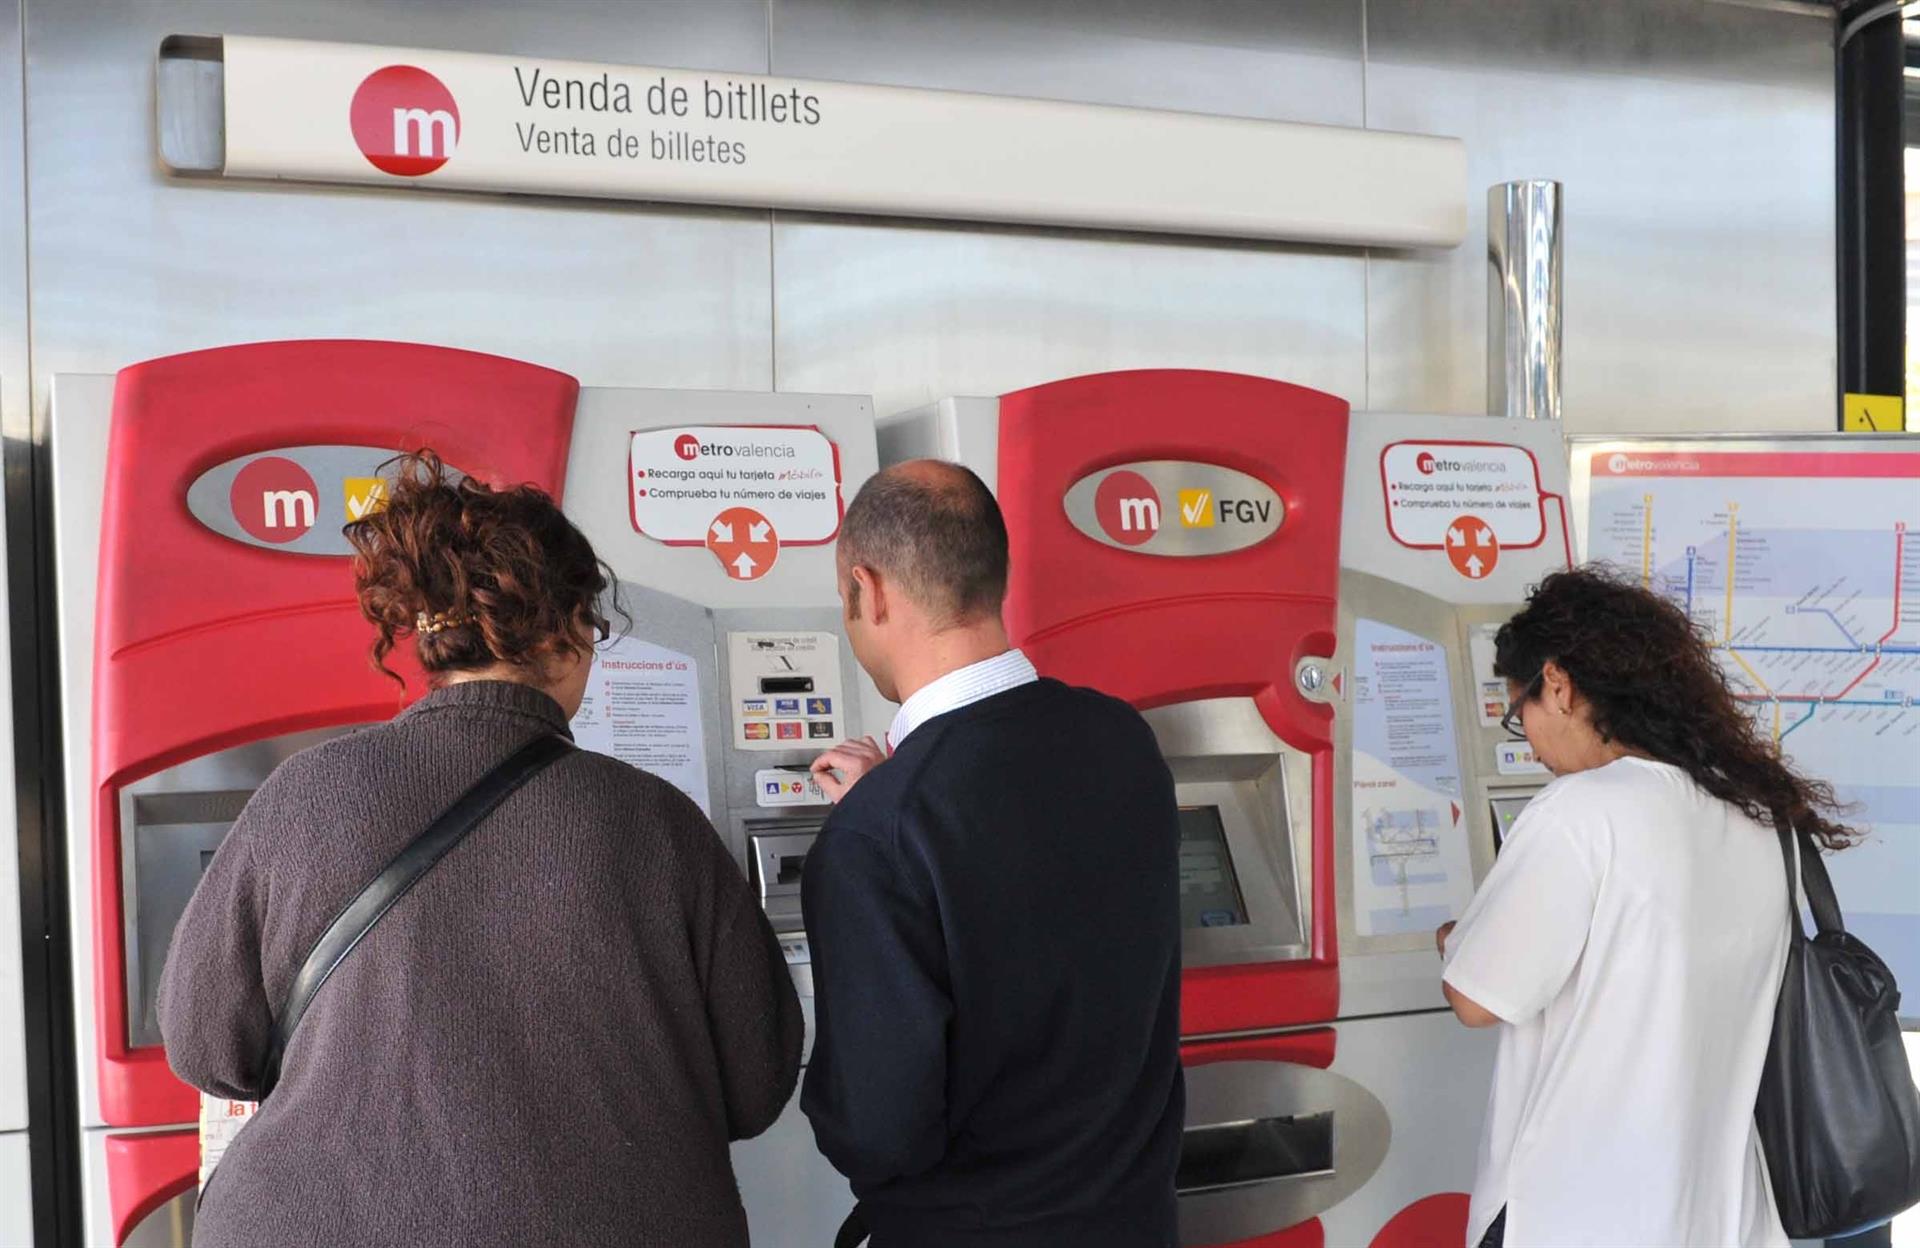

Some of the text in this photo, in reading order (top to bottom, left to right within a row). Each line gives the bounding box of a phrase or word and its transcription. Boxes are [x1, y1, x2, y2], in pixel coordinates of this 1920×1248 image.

[514, 66, 821, 125] Venda de bitllets
[392, 106, 458, 158] m
[515, 122, 746, 165] Venta de billetes
[678, 440, 795, 459] metrovalencia
[648, 468, 696, 481] Recarga
[726, 469, 737, 480] tu
[739, 469, 775, 481] tarjeta
[1419, 456, 1506, 474] metrovalencia
[649, 487, 827, 501] Comprueba tu número de viajes
[263, 489, 316, 528] m
[1119, 497, 1271, 531] m FGV
[601, 660, 664, 671] Instruccions
[747, 703, 764, 711] VISA
